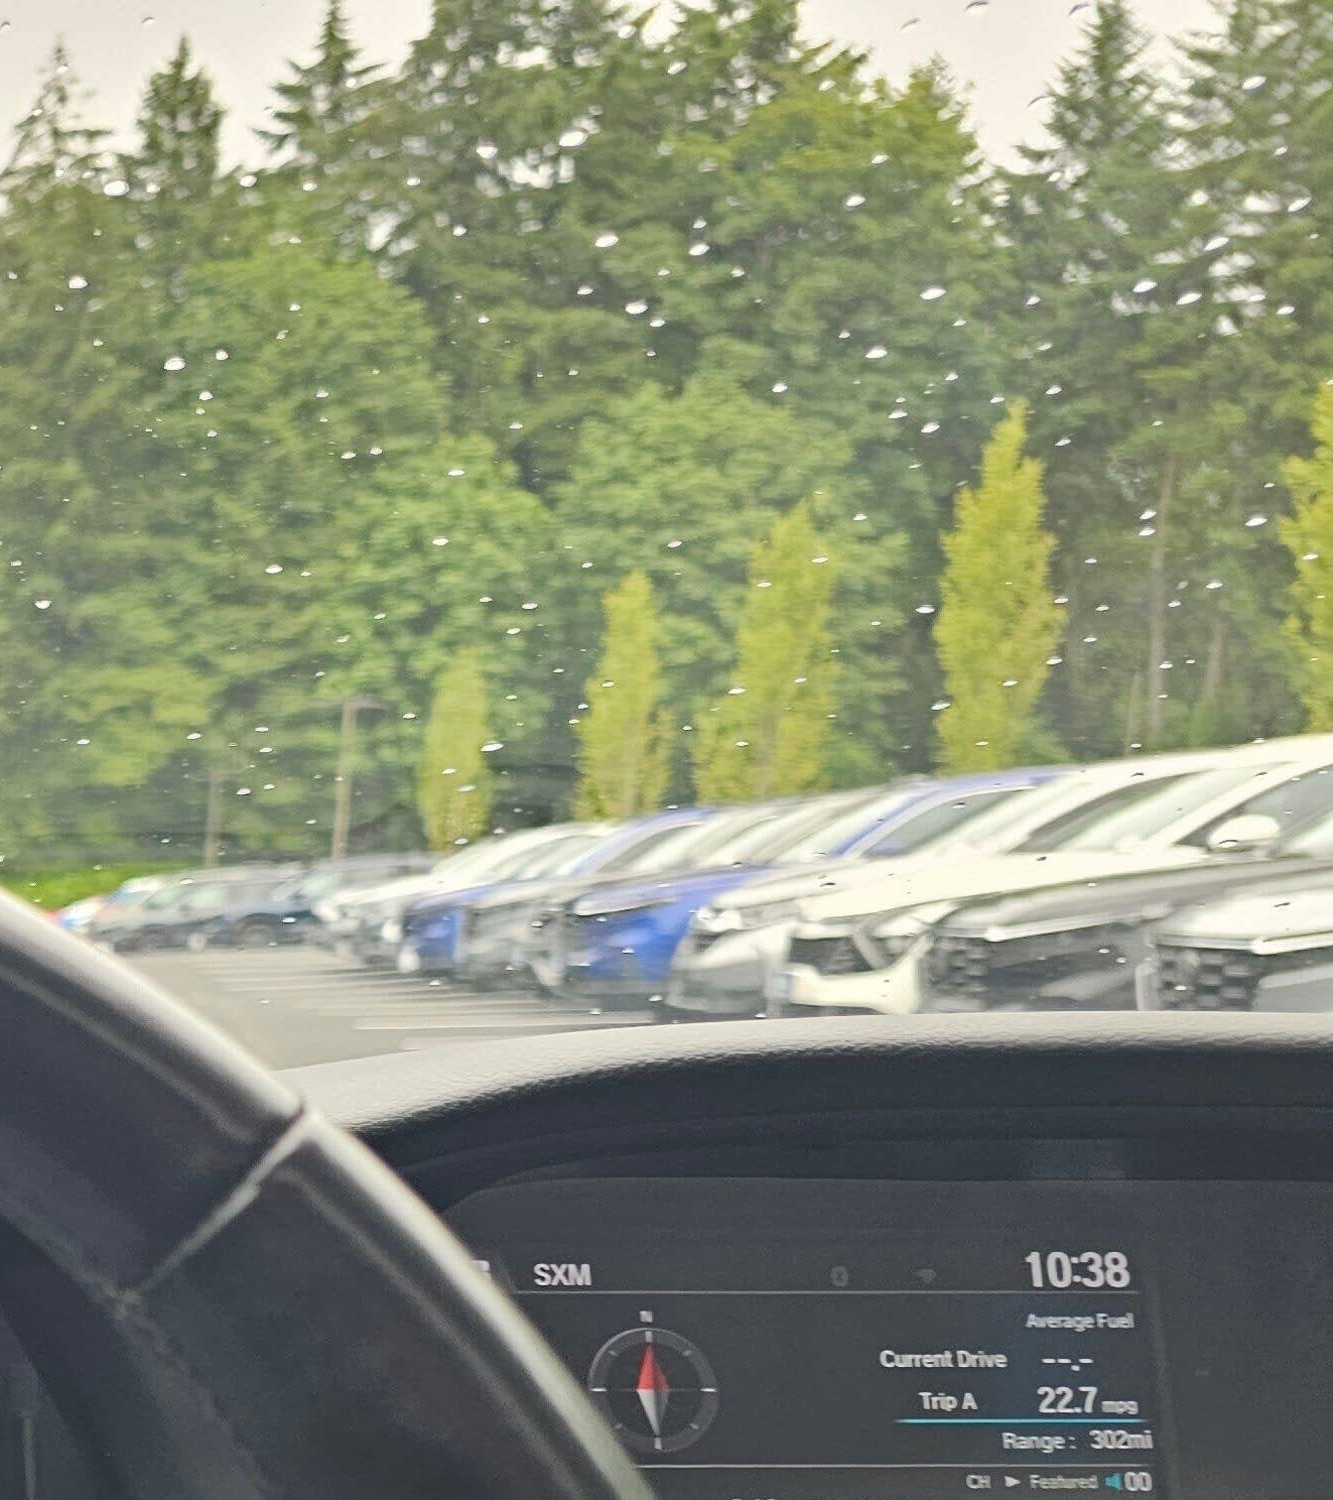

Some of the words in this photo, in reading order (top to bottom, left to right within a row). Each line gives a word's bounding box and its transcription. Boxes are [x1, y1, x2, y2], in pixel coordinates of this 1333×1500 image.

[533, 1263, 592, 1287] SXM
[1024, 1251, 1131, 1288] 10:38
[1025, 1312, 1095, 1333] Average
[1096, 1311, 1135, 1330] Fuel
[879, 1350, 954, 1369] Current
[956, 1350, 1008, 1369] Drive
[918, 1391, 958, 1412] Trip
[961, 1392, 979, 1410] A
[1037, 1386, 1098, 1414] 22.7
[1101, 1400, 1139, 1415] mpg
[966, 1475, 991, 1490] CH
[1124, 1472, 1153, 1492] 00
